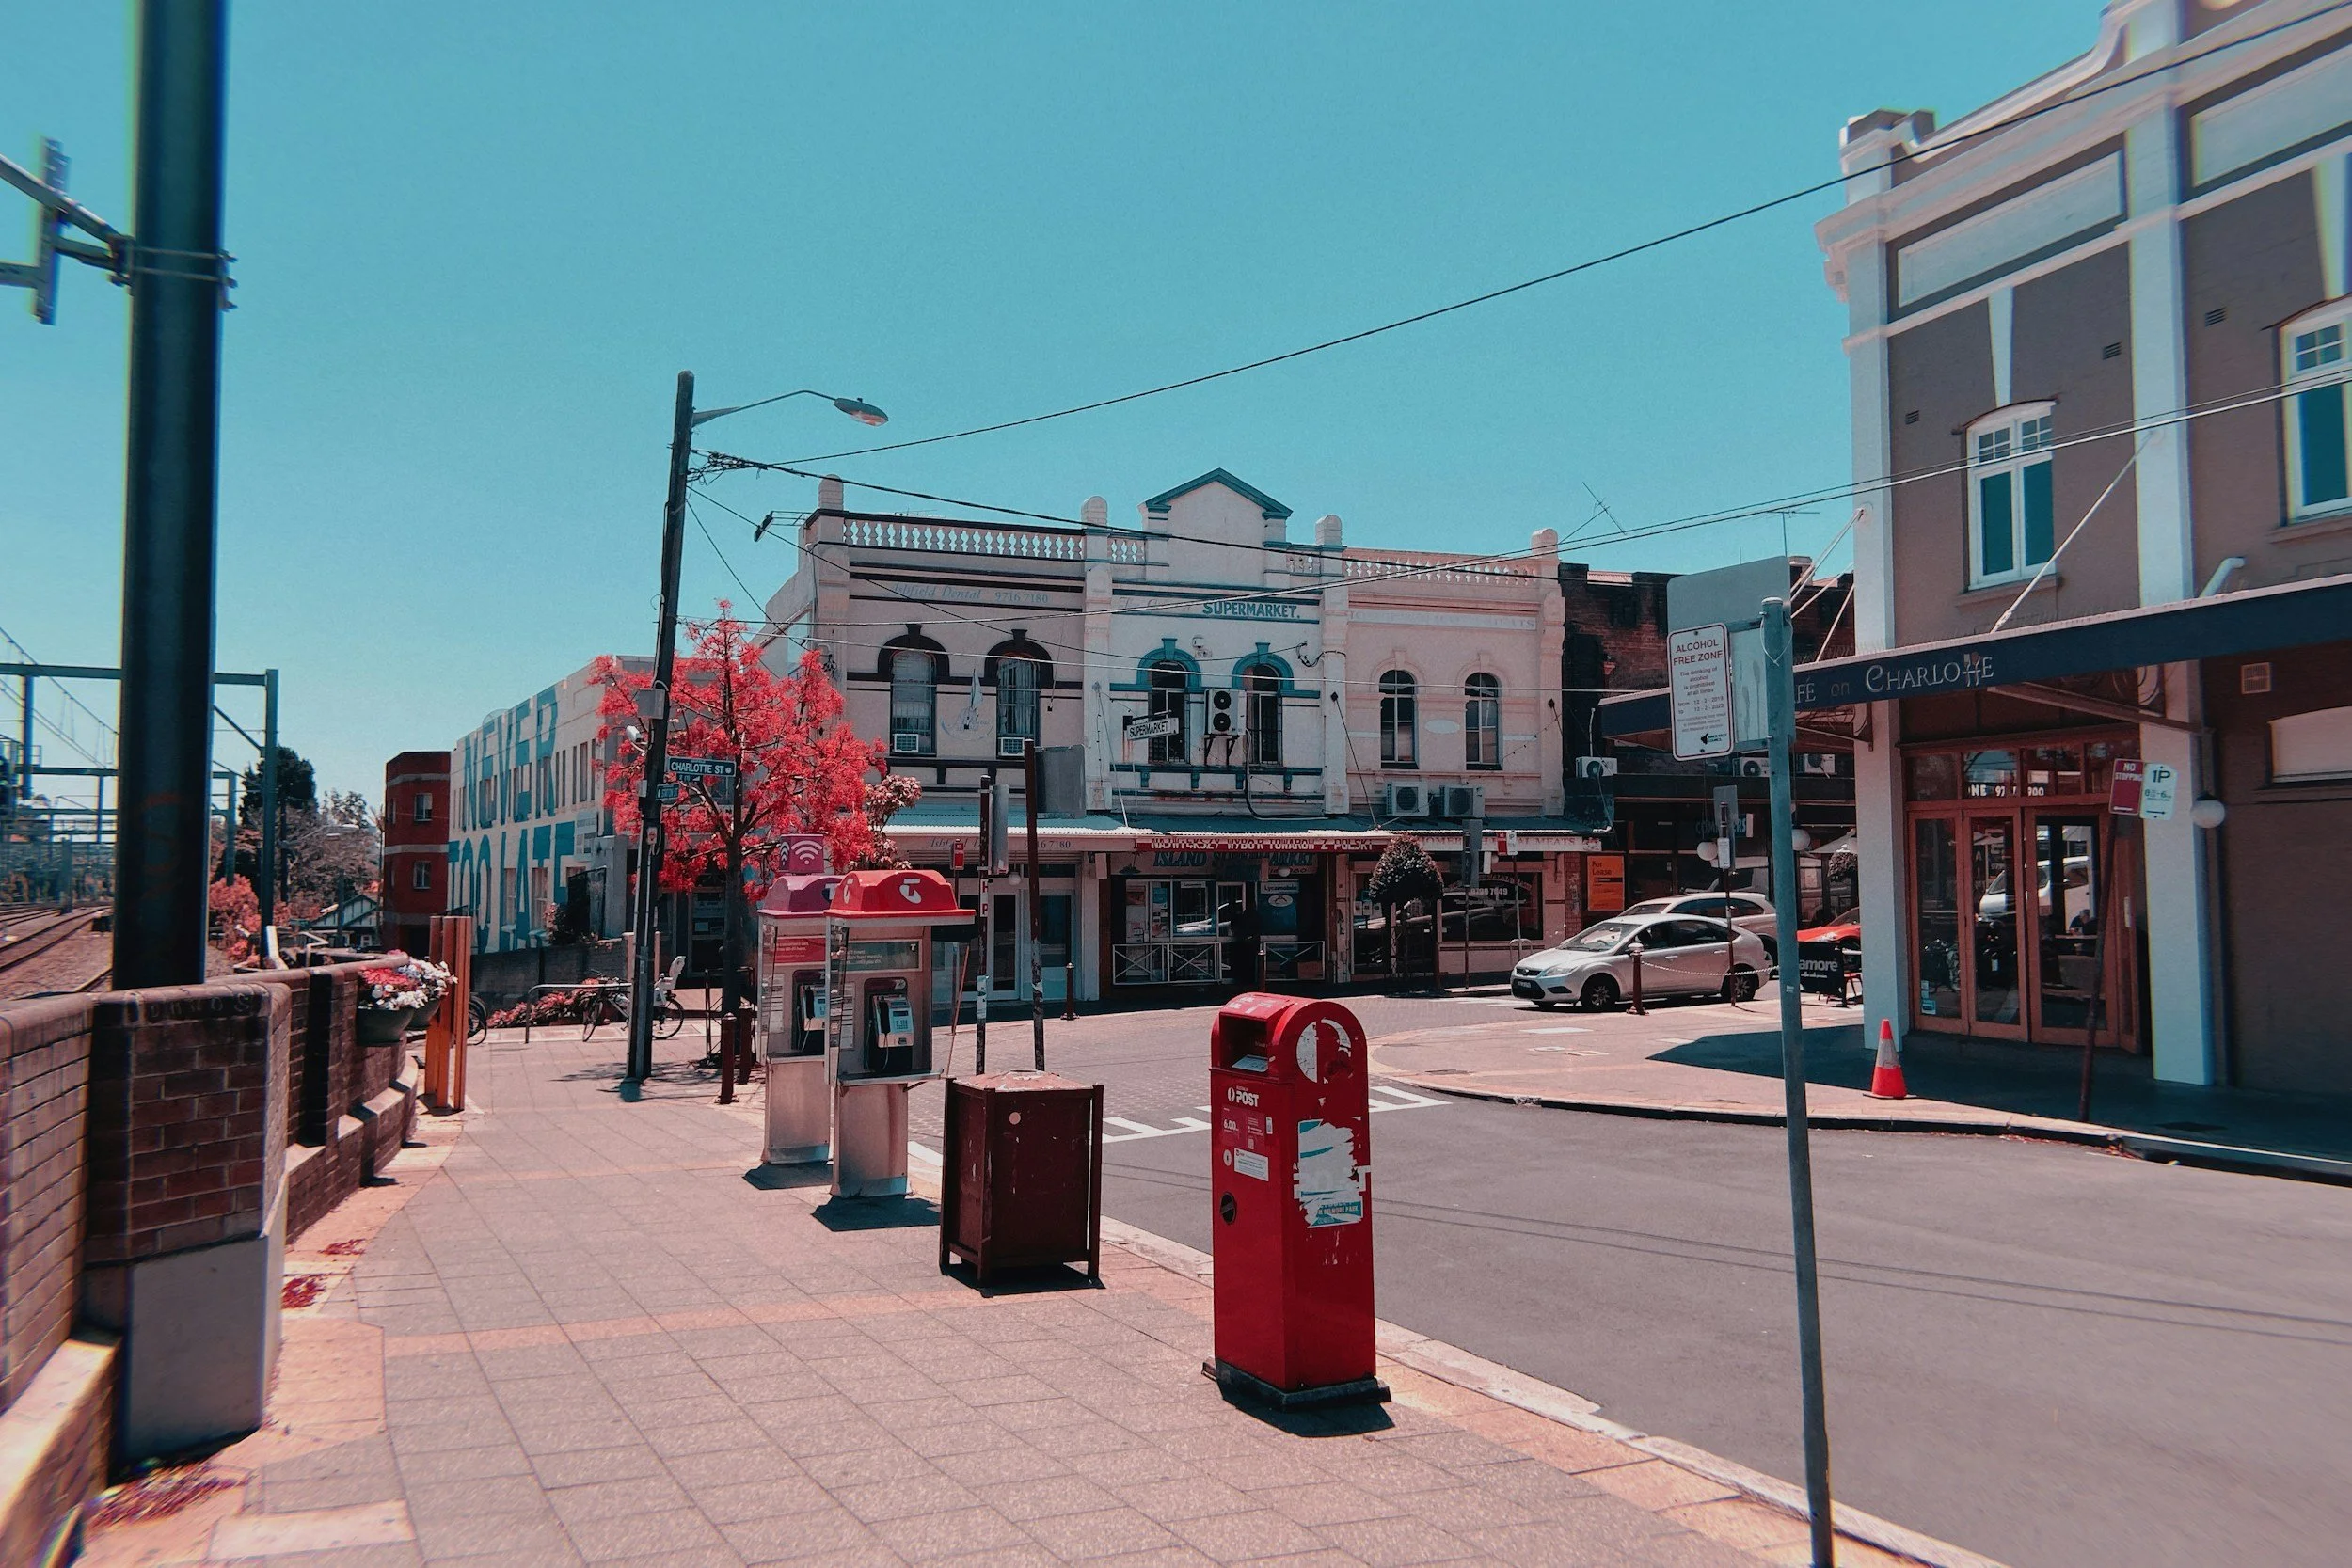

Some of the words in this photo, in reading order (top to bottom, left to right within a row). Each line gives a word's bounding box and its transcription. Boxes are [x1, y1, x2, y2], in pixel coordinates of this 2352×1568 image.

[942, 585, 982, 599] Dental
[995, 592, 1021, 603] 9716
[1024, 593, 1049, 604] 7180
[1676, 639, 1719, 653] ALCOHOL
[1674, 654, 1696, 666] FREE
[1697, 650, 1723, 662] ZONE
[1793, 677, 1816, 705] FÉ
[1830, 682, 1850, 697] on
[1130, 721, 1169, 737] SUPERMARKET
[463, 685, 559, 834] NEVER
[2123, 763, 2136, 771] NO
[671, 762, 713, 773] CHARLOTTE
[714, 765, 724, 775] ST
[2152, 770, 2170, 783] 1P
[1049, 840, 1071, 848] 7180
[1799, 959, 1838, 972] amore
[1236, 1091, 1259, 1107] POST
